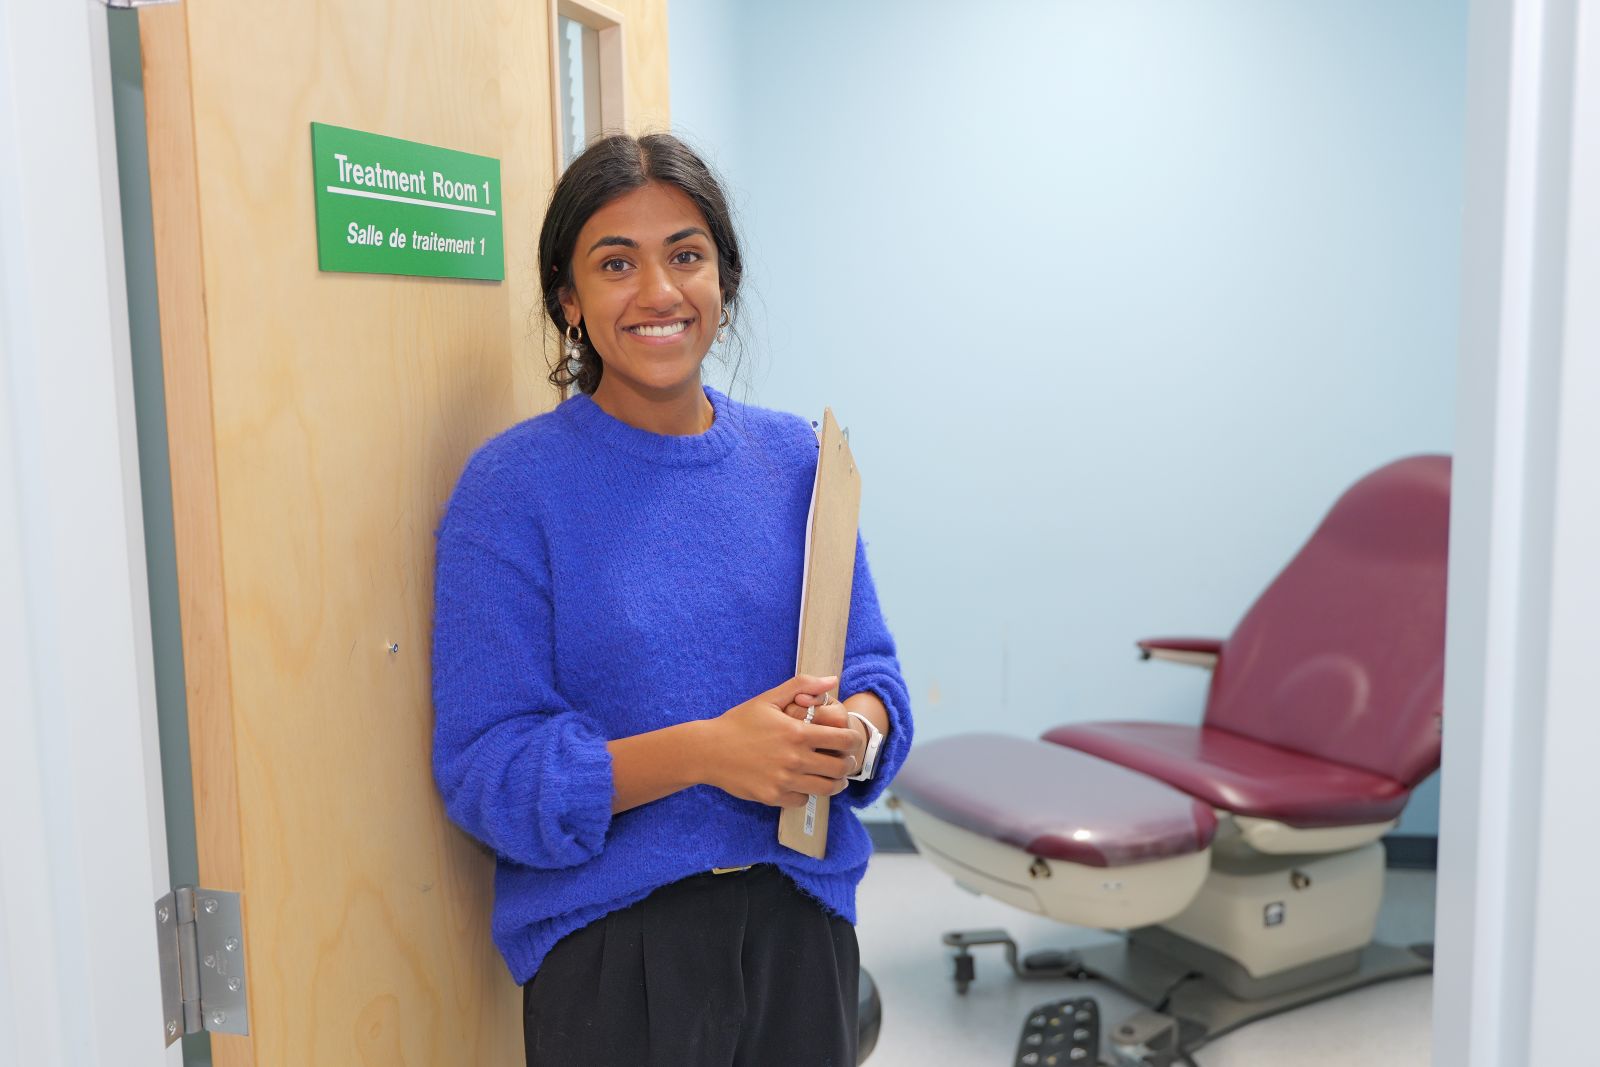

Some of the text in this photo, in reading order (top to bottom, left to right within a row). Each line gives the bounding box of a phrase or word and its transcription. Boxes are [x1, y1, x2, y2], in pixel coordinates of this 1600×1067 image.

[334, 153, 490, 205] Treatment Room 1
[346, 221, 486, 256] Salle de traitement 1
